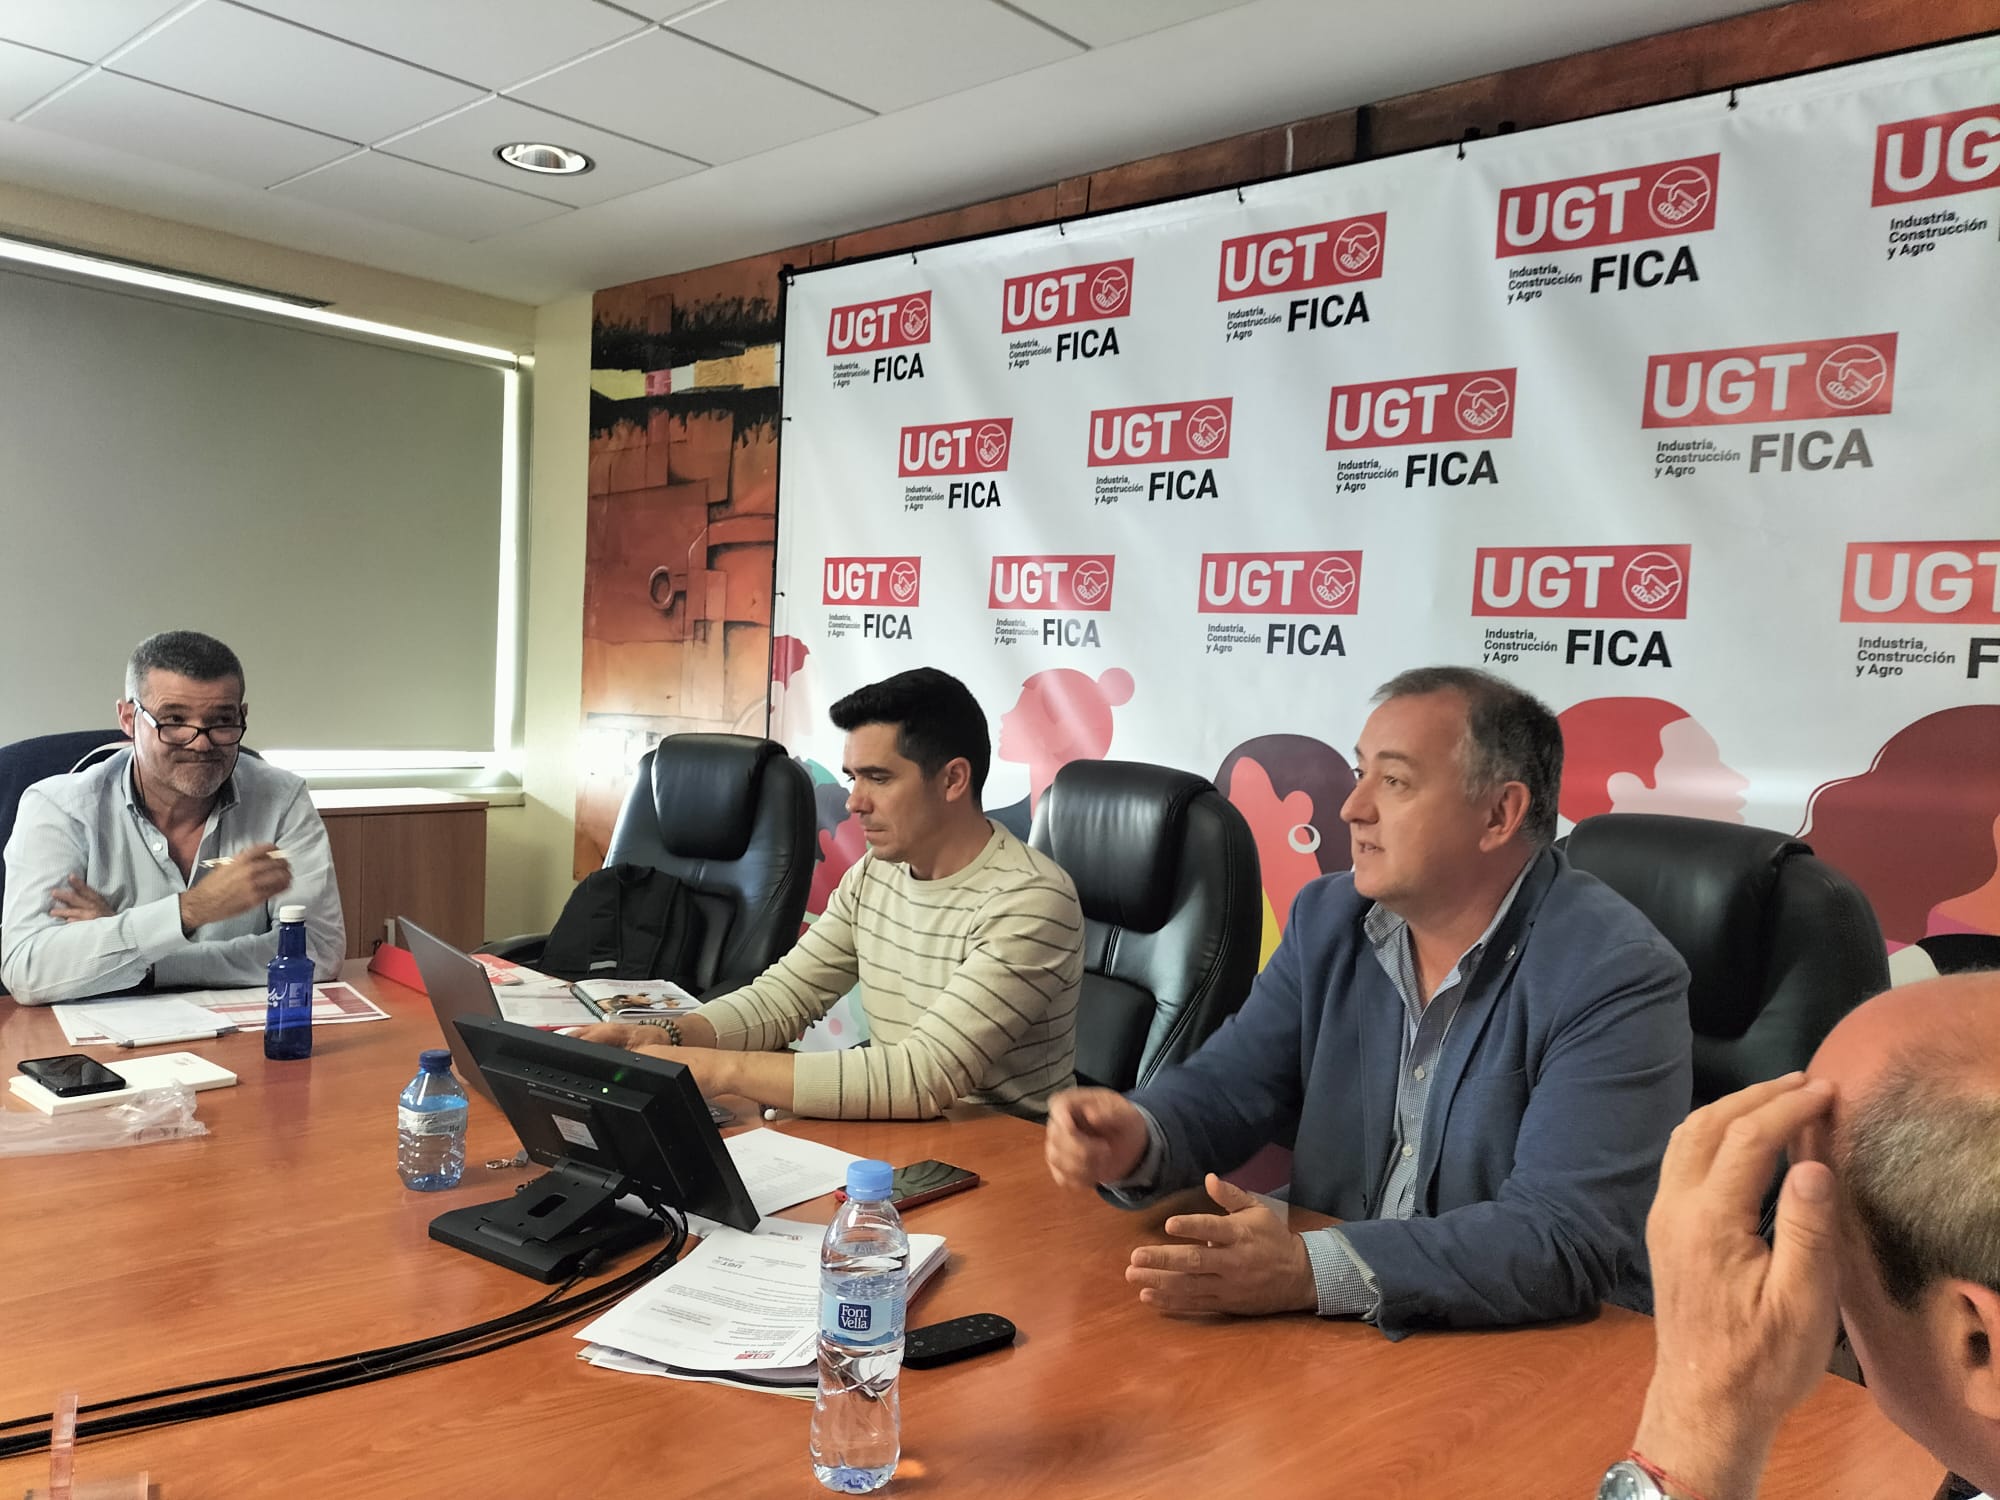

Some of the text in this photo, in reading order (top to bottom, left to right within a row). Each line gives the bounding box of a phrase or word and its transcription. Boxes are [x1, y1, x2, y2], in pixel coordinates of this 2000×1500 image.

[1504, 178, 1641, 247] UGT
[1890, 210, 1960, 231] Industria,
[1889, 218, 1988, 243] Construcción
[1887, 242, 1936, 261] y Agro
[1225, 232, 1328, 292] UGT
[1589, 245, 1700, 294] FICA
[1508, 273, 1582, 290] Construcción
[1509, 264, 1561, 280] Industria,
[1008, 274, 1087, 326] UGT
[1516, 291, 1542, 302] Agro
[1227, 313, 1282, 330] Construcción
[1228, 306, 1265, 320] Industria,
[1287, 291, 1371, 334] FICA
[832, 305, 898, 350] UGT
[1233, 330, 1253, 341] Agro
[1056, 327, 1120, 363] FICA
[873, 352, 925, 385] FICA
[1653, 353, 1808, 419] UGT
[1335, 384, 1449, 442] UGT
[1094, 411, 1182, 460] UGT
[903, 428, 972, 471] UGT
[1657, 439, 1717, 452] Industria,
[1749, 428, 1874, 474] FICA
[1337, 459, 1381, 471] Industria,
[1656, 449, 1741, 464] Construcción
[1337, 468, 1399, 481] Construcción
[1405, 450, 1500, 488] FICA
[1655, 465, 1695, 479] y Agro
[1096, 475, 1130, 485] Industria,
[1096, 483, 1143, 494] Construcción
[1148, 468, 1219, 502] FICA
[1343, 482, 1366, 493] Agro
[948, 480, 1002, 510] FICA
[1101, 495, 1118, 504] Agro
[827, 563, 887, 600] UGT
[994, 562, 1074, 603] UGT
[1205, 560, 1305, 607] UGT
[1481, 556, 1615, 609] UGT
[864, 614, 913, 641] FICA
[1043, 619, 1101, 649] FICA
[1208, 624, 1246, 634] Industria,
[1485, 628, 1537, 641] Industria,
[1207, 633, 1261, 643] Construcción
[1267, 623, 1347, 657] FICA
[1484, 639, 1558, 652] Construcción
[1858, 636, 1928, 652] Industria,
[1213, 644, 1232, 654] Agro
[1483, 651, 1519, 664] y Agro
[1565, 629, 1673, 668] FICA
[1857, 649, 1956, 664] Construcción
[1855, 663, 1904, 678] y Agro
[841, 1304, 868, 1317] Font
[841, 1316, 868, 1329] Vella
